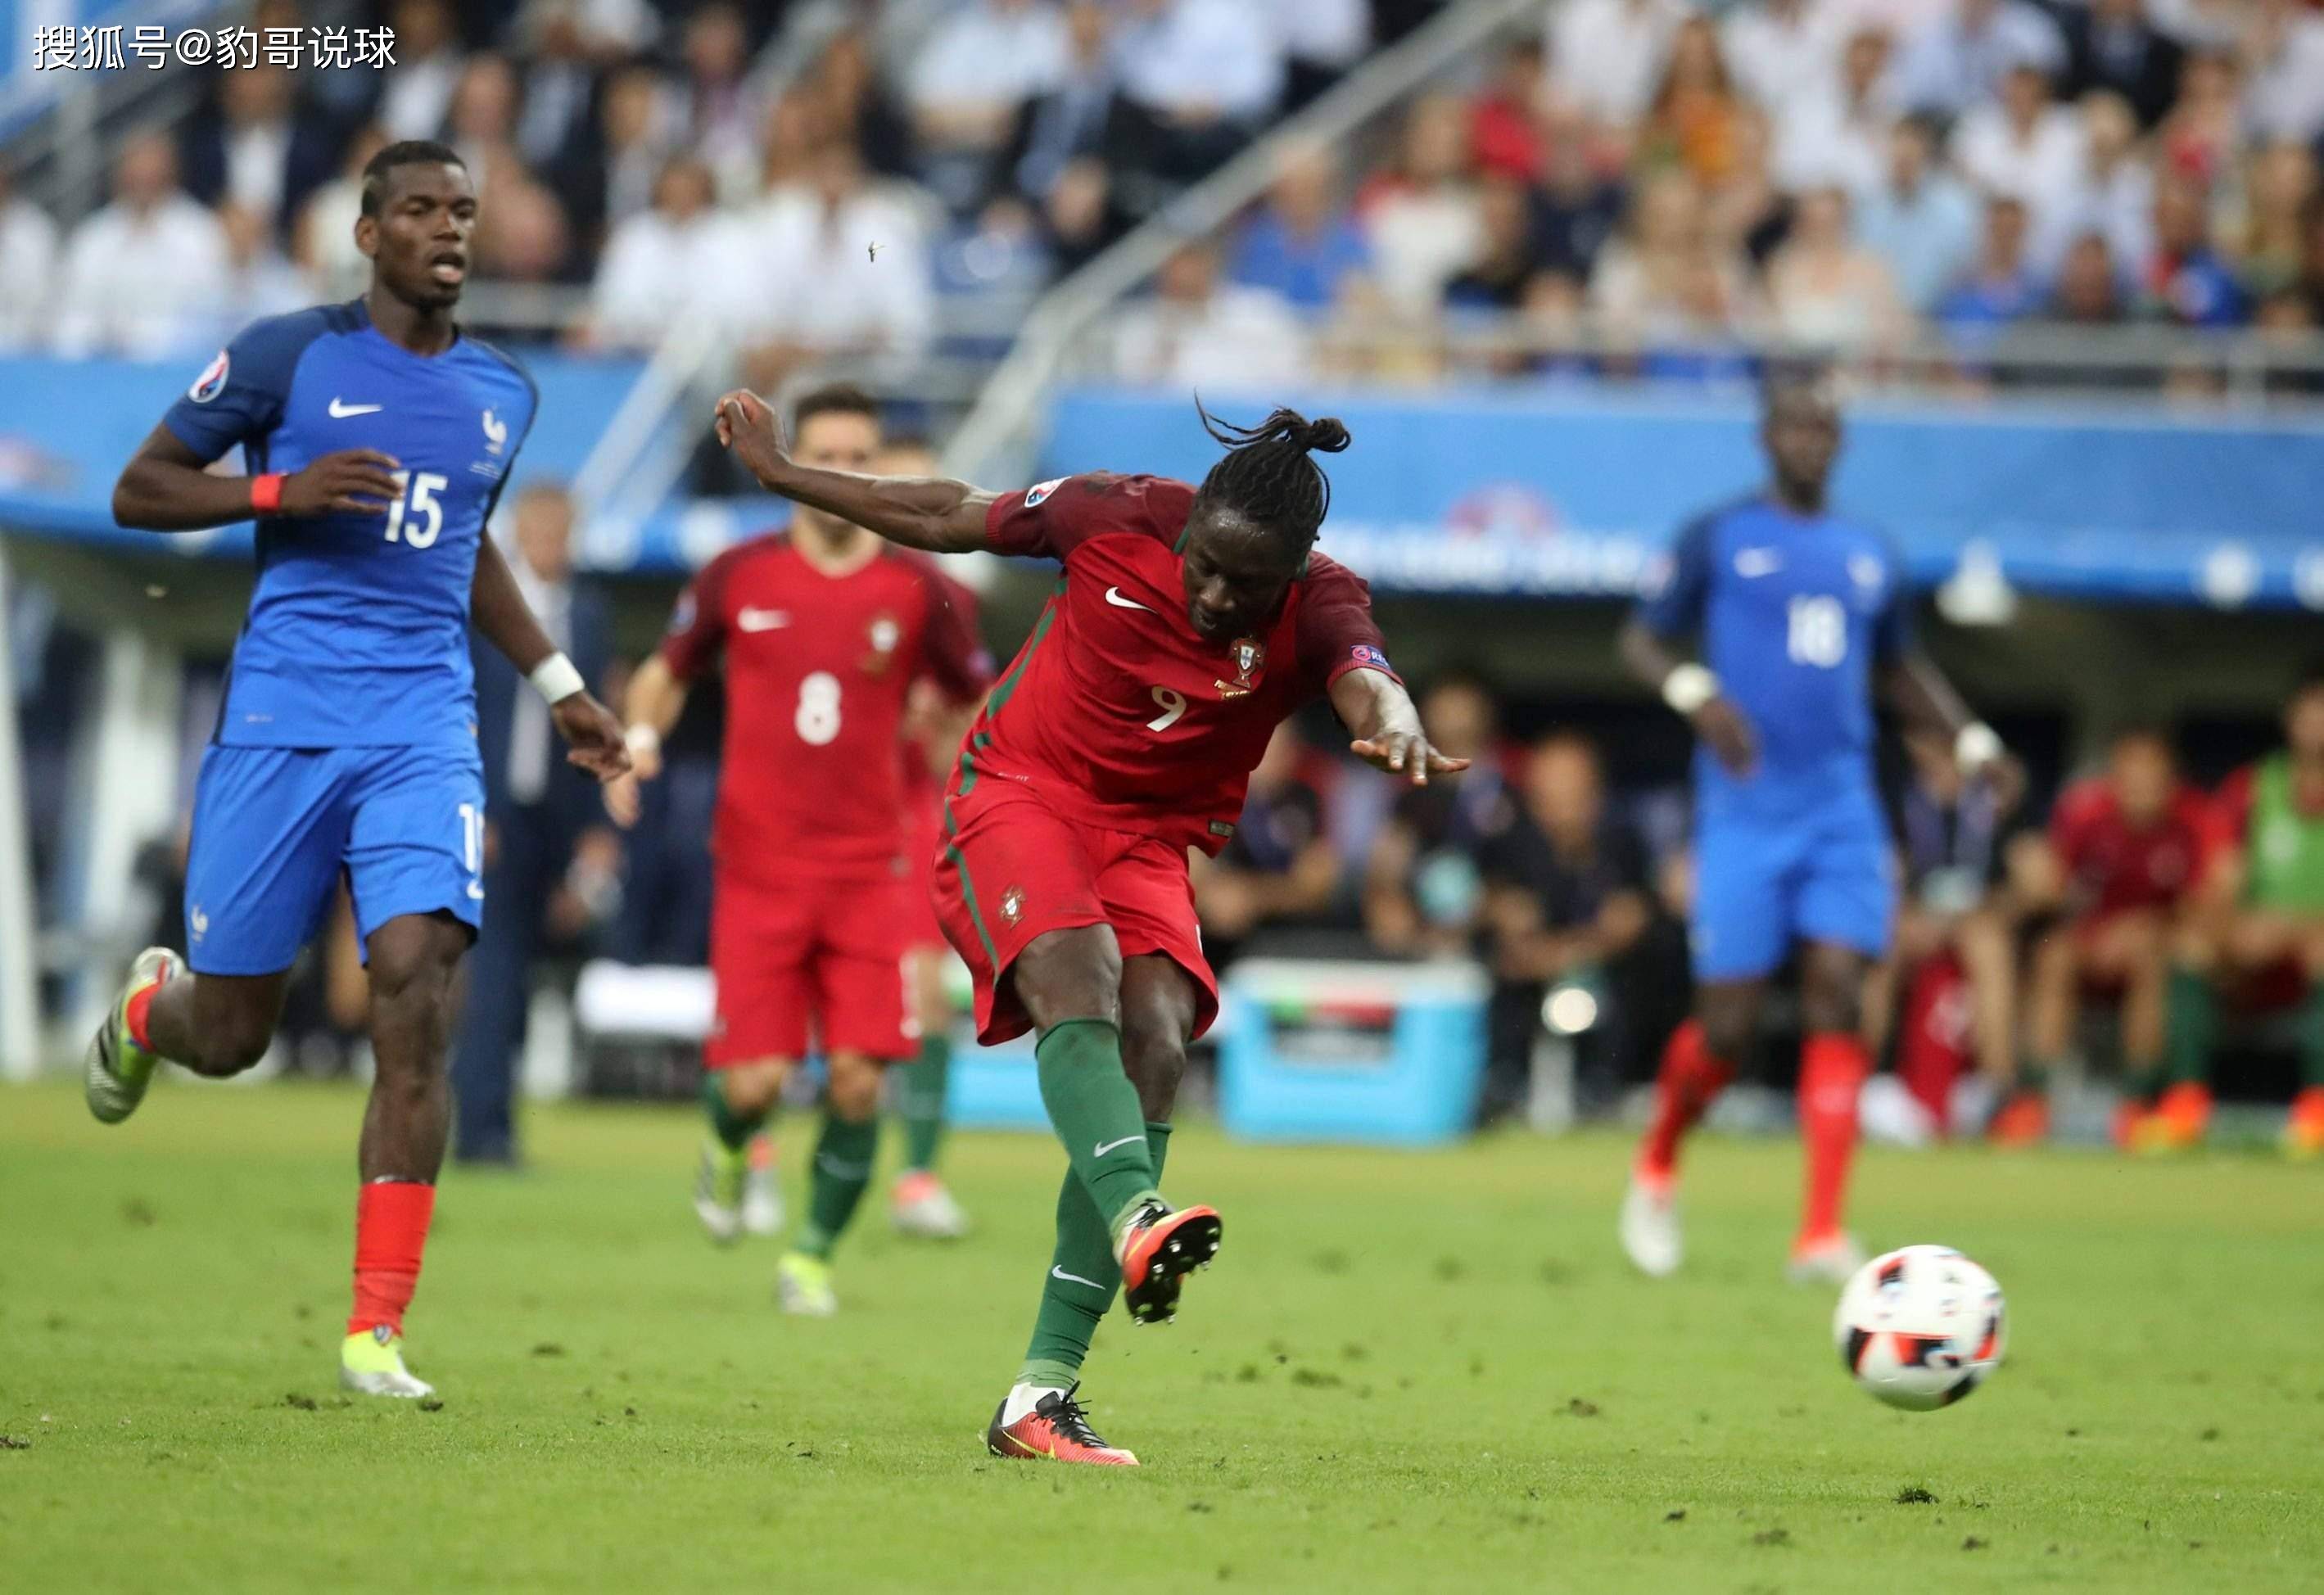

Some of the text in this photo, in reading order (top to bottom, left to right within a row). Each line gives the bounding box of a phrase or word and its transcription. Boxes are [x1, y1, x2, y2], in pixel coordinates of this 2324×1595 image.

[384, 469, 448, 549] 15
[1787, 594, 1847, 667] 18
[795, 670, 842, 746] 8
[1146, 685, 1187, 733] 9
